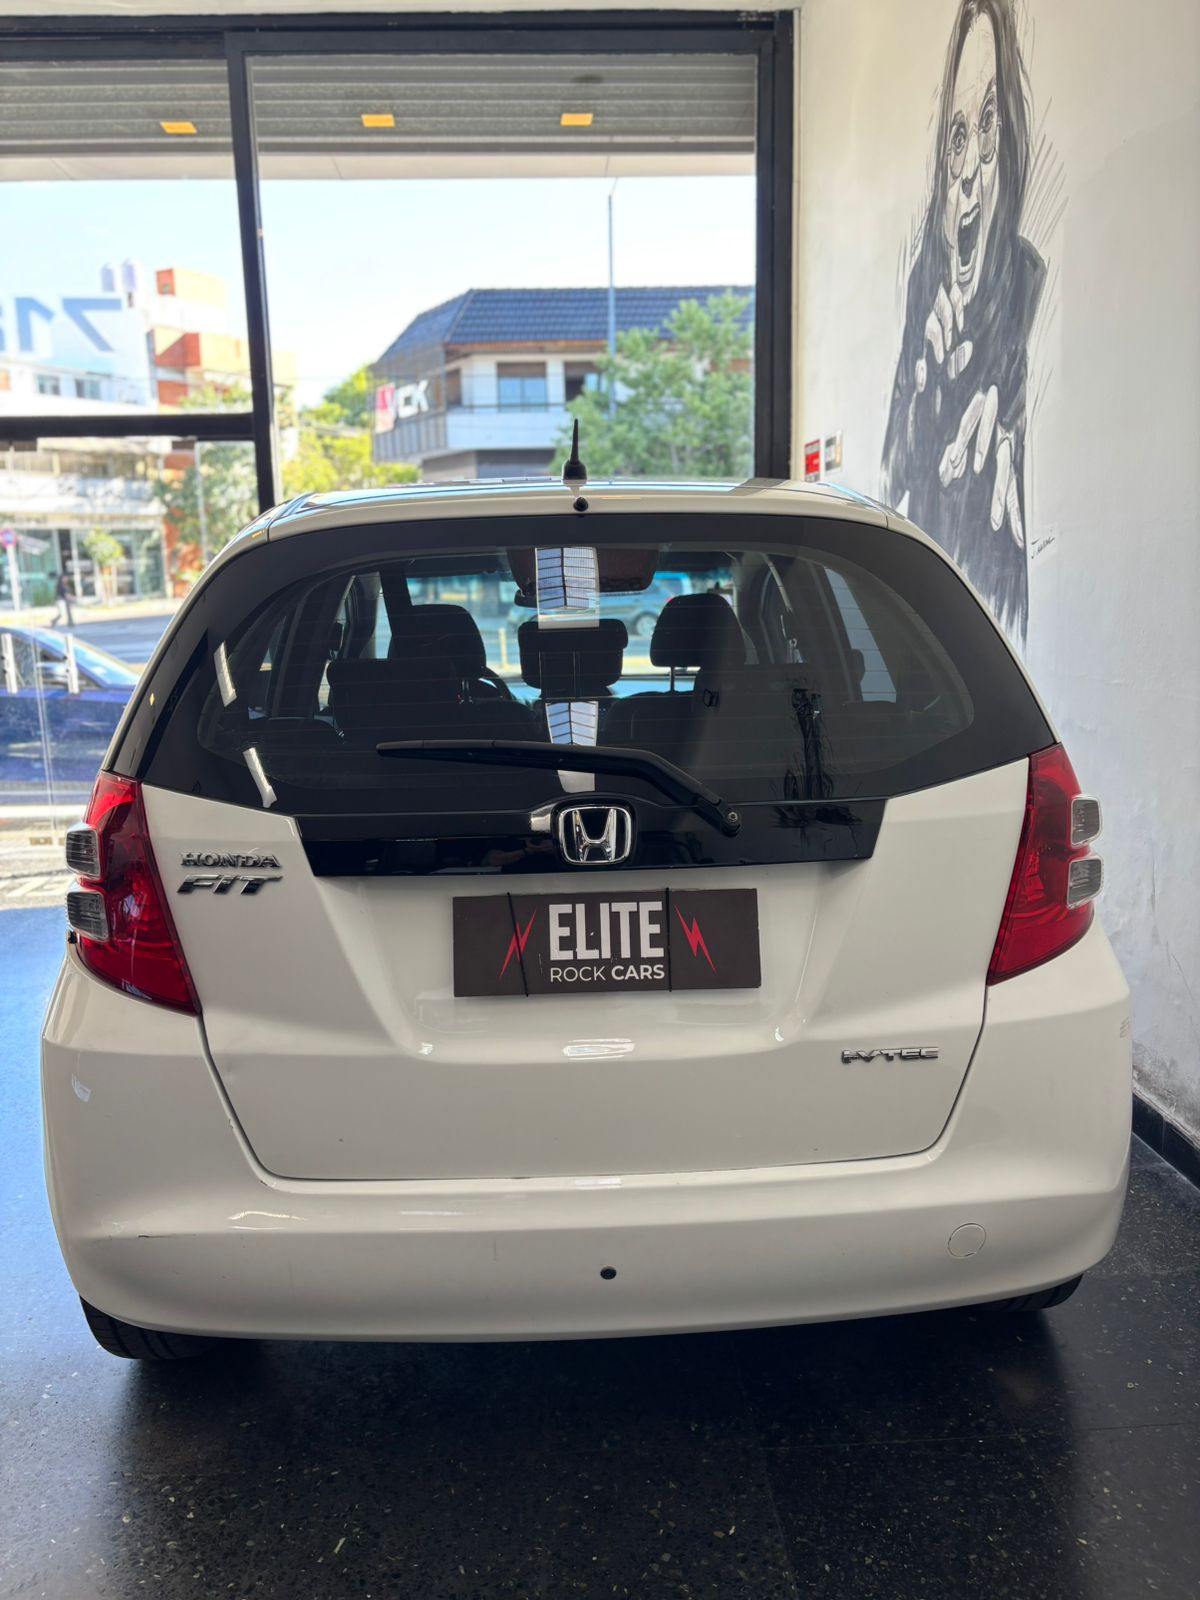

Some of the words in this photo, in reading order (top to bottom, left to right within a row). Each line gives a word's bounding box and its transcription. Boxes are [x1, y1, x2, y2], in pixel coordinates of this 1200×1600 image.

[181, 852, 281, 868] HONDA
[177, 874, 283, 895] FIT
[548, 901, 665, 961] ELITE
[550, 966, 606, 983] ROCK
[611, 964, 665, 981] CARS
